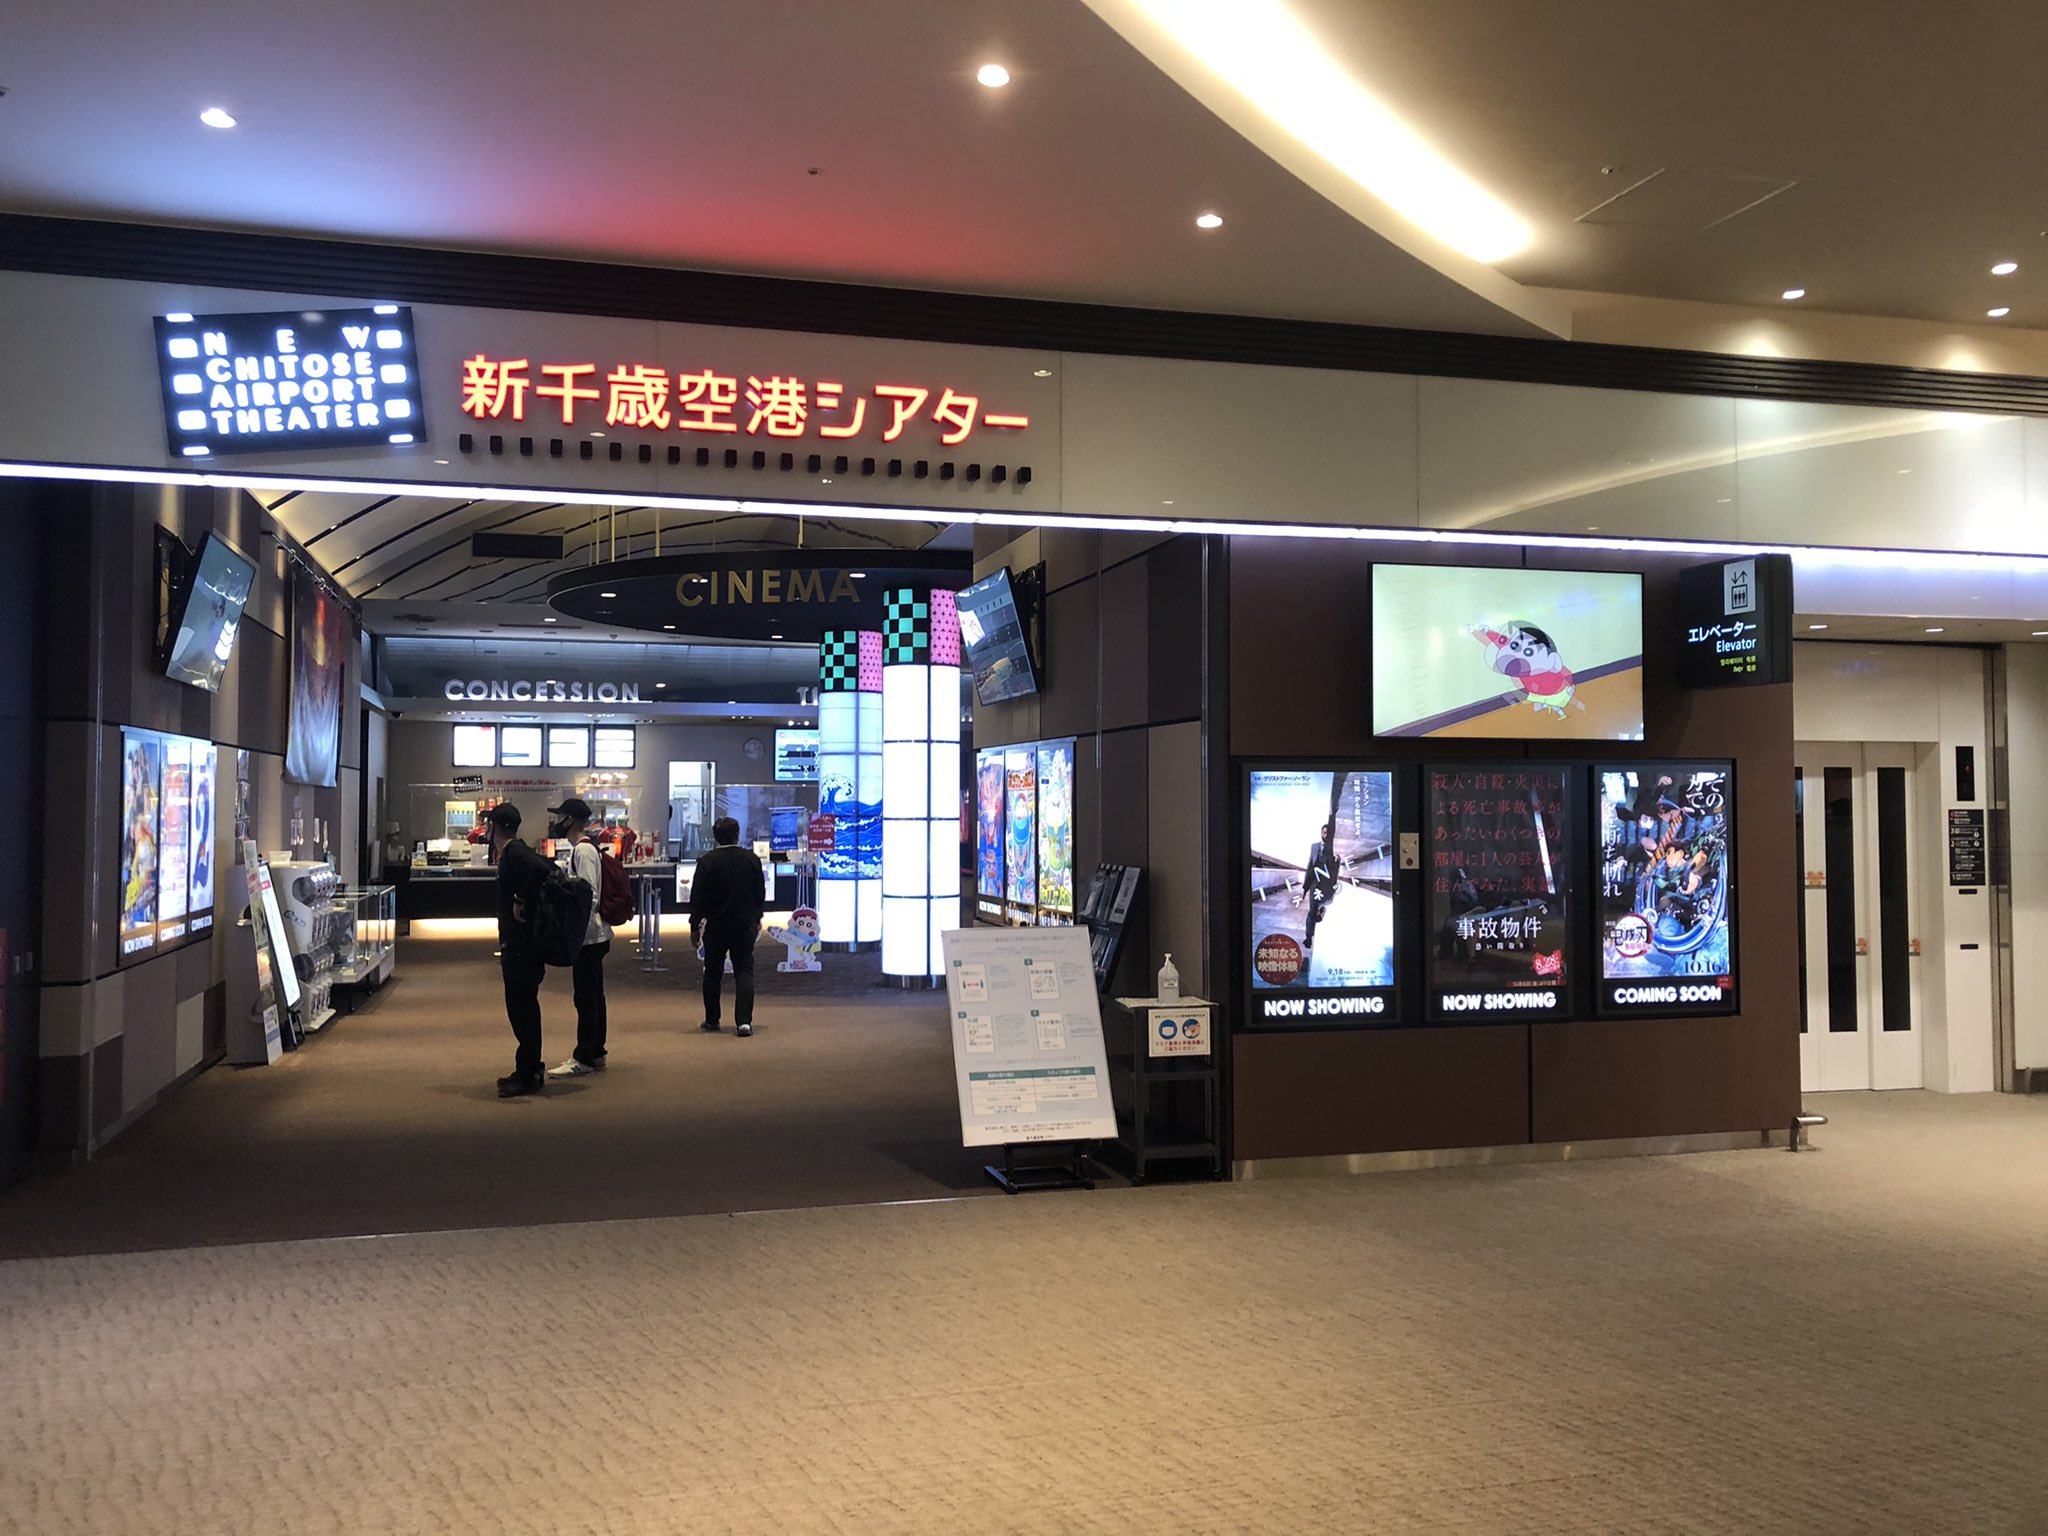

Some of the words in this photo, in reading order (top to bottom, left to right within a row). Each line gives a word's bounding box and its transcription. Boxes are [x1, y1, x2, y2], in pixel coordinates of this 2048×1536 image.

[203, 326, 370, 356] NEW
[206, 351, 375, 383] CHITOSE
[210, 377, 376, 409] AIRPORT
[460, 354, 1028, 446] 新千歳空港シアター
[211, 402, 379, 435] THEATER
[676, 569, 860, 607] CINEMA
[1688, 621, 1757, 642] エレベーター
[1716, 639, 1757, 653] Elevator
[444, 679, 639, 702] CONCESSION
[1433, 774, 1559, 789] 殺人・自殺・火災に
[1455, 916, 1542, 940] 事故物件
[1258, 947, 1298, 959] 未知なる
[1258, 961, 1298, 972] 映像体験
[1328, 968, 1343, 976] 9.18
[1443, 994, 1481, 1011] NOW
[1484, 992, 1556, 1010] SHOWING
[1614, 986, 1677, 1004] COMING
[1680, 985, 1721, 1002] SOON
[1264, 999, 1305, 1016] NOW
[1308, 997, 1385, 1016] SHOWING
